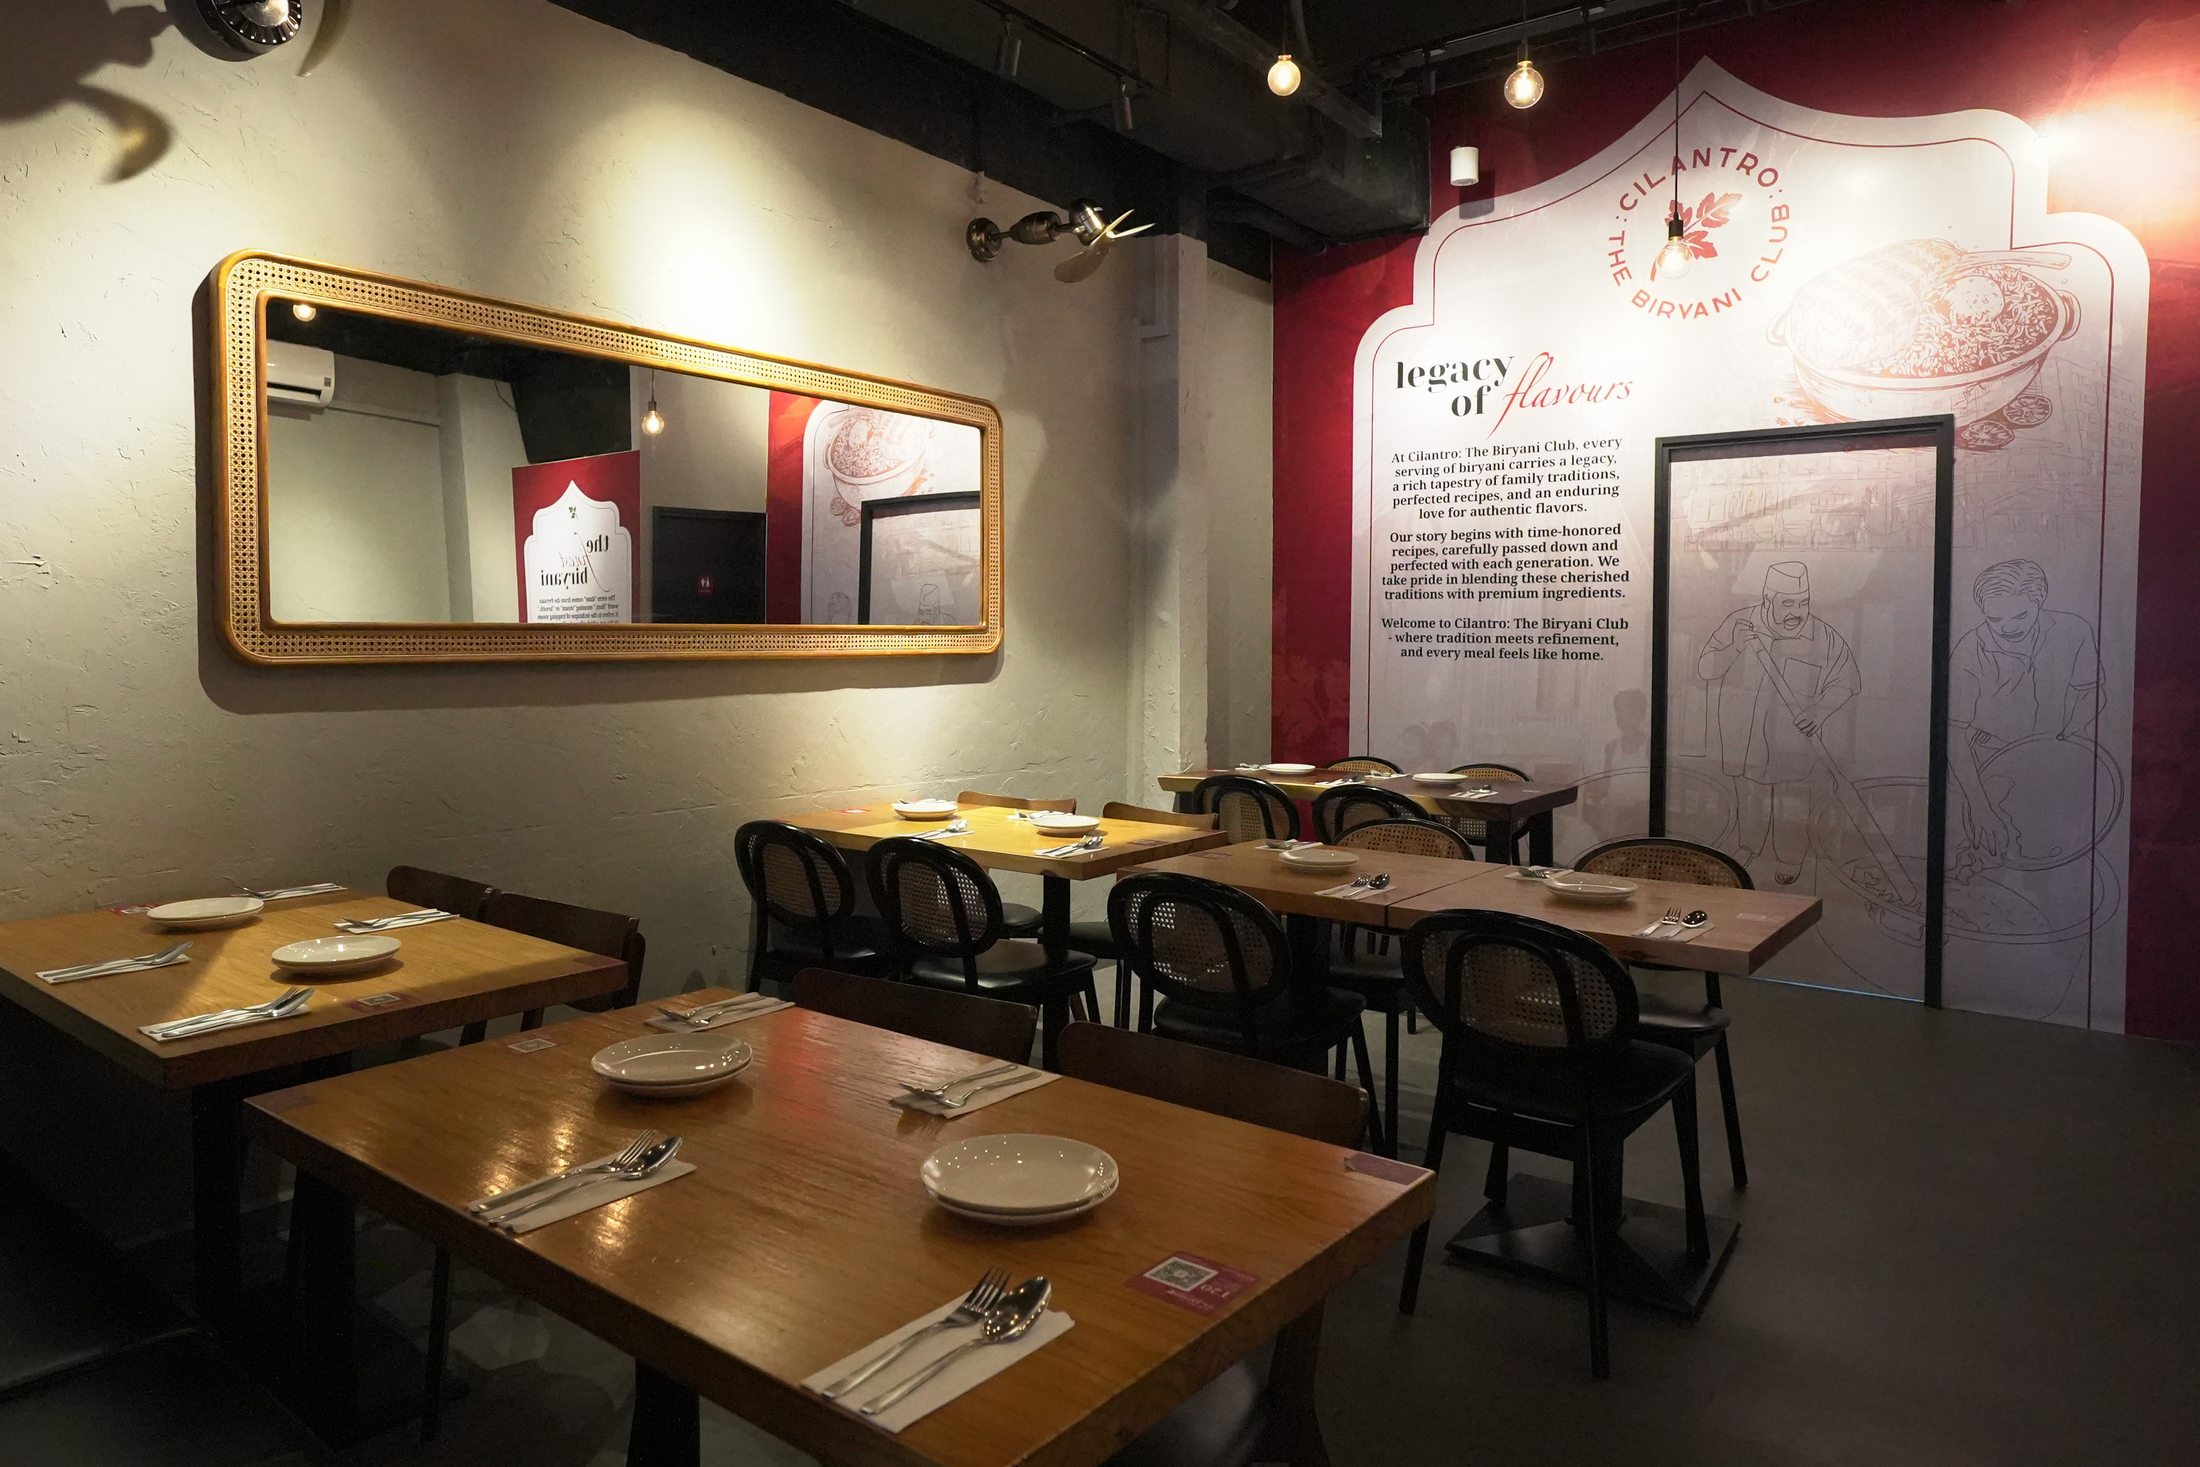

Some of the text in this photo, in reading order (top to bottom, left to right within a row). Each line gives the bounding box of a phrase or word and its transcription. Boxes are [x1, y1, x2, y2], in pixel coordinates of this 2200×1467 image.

[1619, 147, 1779, 211] CILANTRO
[1608, 204, 1790, 319] THE BIRYANI CLUB
[1394, 356, 1515, 393] legacy
[1451, 351, 1633, 440] of flavours
[1392, 439, 1622, 463] At Cilantro: The Biryani Club, every
[1395, 455, 1617, 478] serving of biryani carries a legacy,
[1392, 469, 1620, 492] a rich tapestry of family traditions,
[1393, 484, 1620, 509] perfected recipes, and an enduring
[1419, 502, 1587, 519] love for authentic flavors.
[1390, 523, 1621, 544] Our story begins with time-honored
[1392, 539, 1618, 559] recipes, carefully passed down and
[1390, 555, 1620, 575] perfected with each generation. We
[1382, 570, 1630, 588] take pride in blending these cherished
[1384, 586, 1625, 602] traditions with premium ingredients.
[1381, 617, 1629, 633] Welcome to Cilantro: The Biryani Club
[1395, 631, 1433, 643] where
[1436, 632, 1492, 644] tradition
[1495, 634, 1534, 645] meets
[1537, 633, 1619, 647] refinement,
[1400, 646, 1604, 661] and every meal feels like home.
